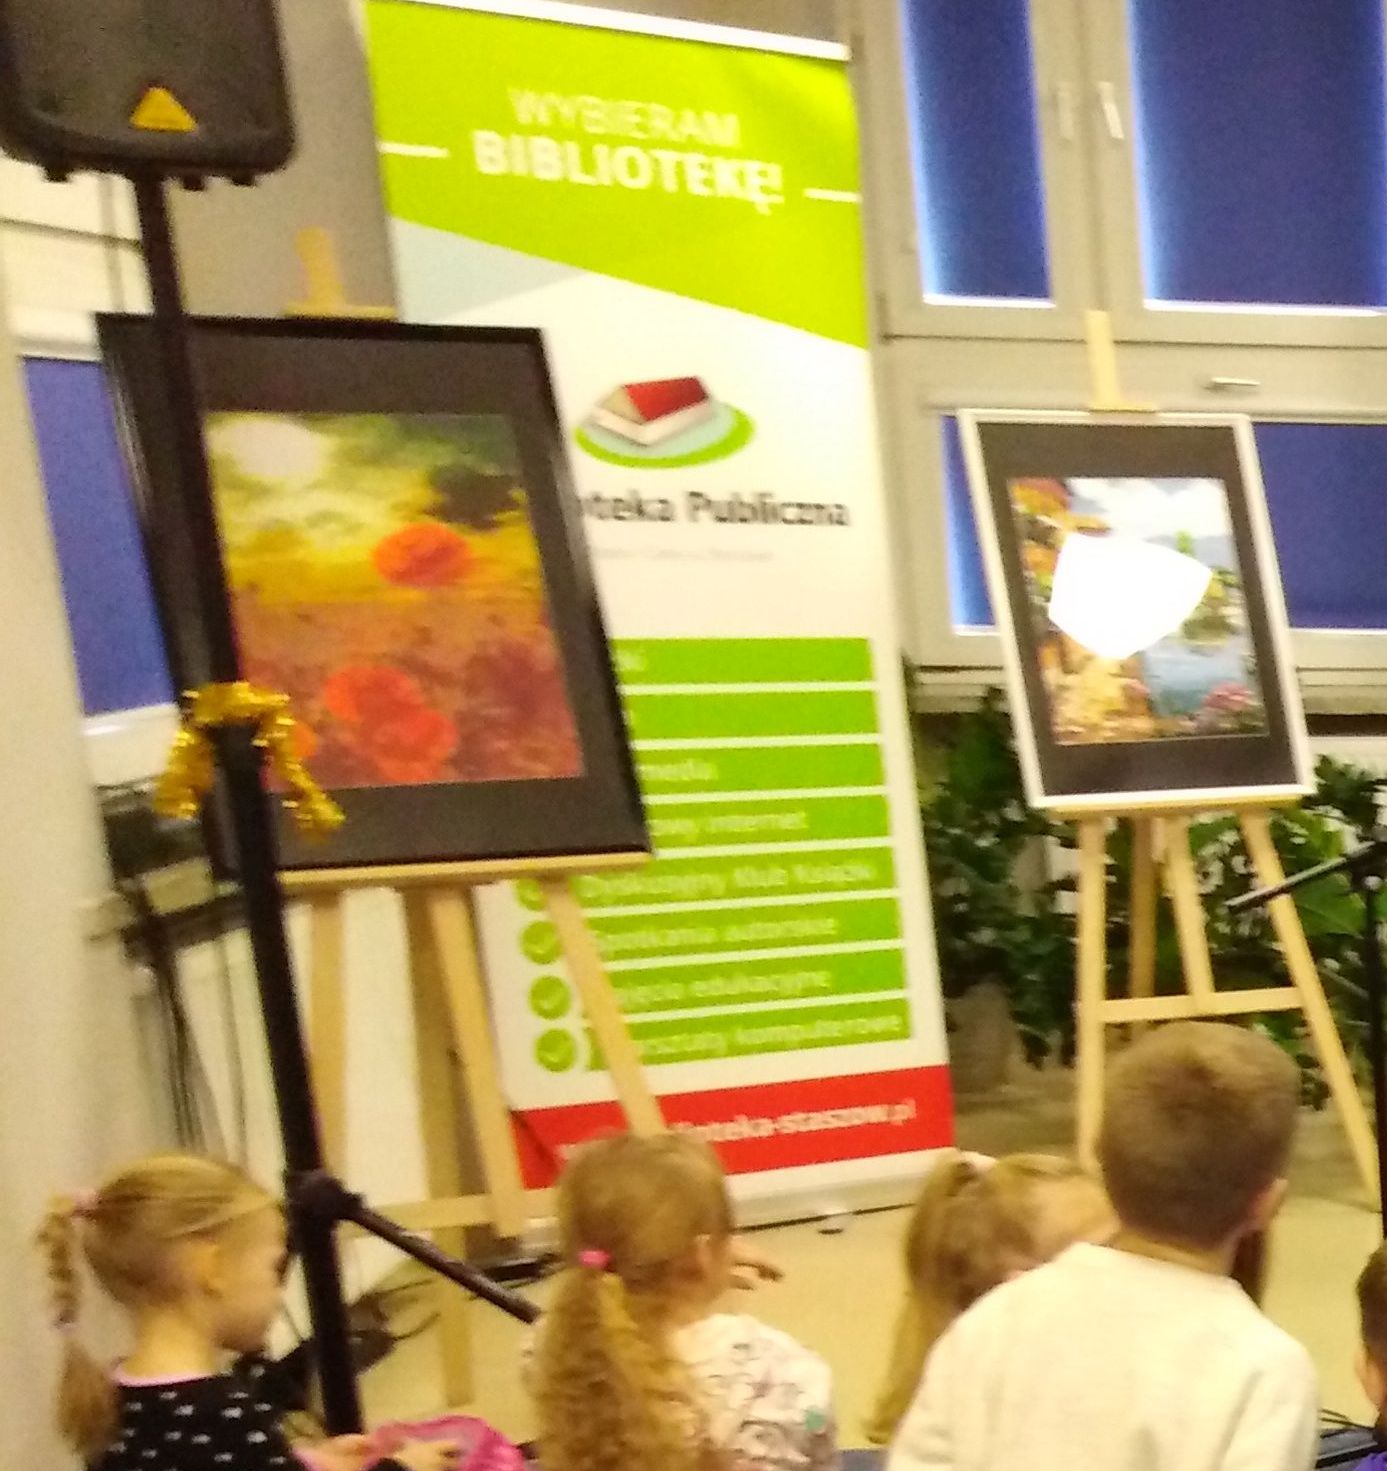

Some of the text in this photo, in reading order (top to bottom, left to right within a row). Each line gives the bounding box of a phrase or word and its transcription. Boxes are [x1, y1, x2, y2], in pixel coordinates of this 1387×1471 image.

[507, 87, 742, 148] WYBIERAM
[472, 129, 785, 216] BIBLIOTEKĘ!
[684, 487, 850, 527] Publiczna
